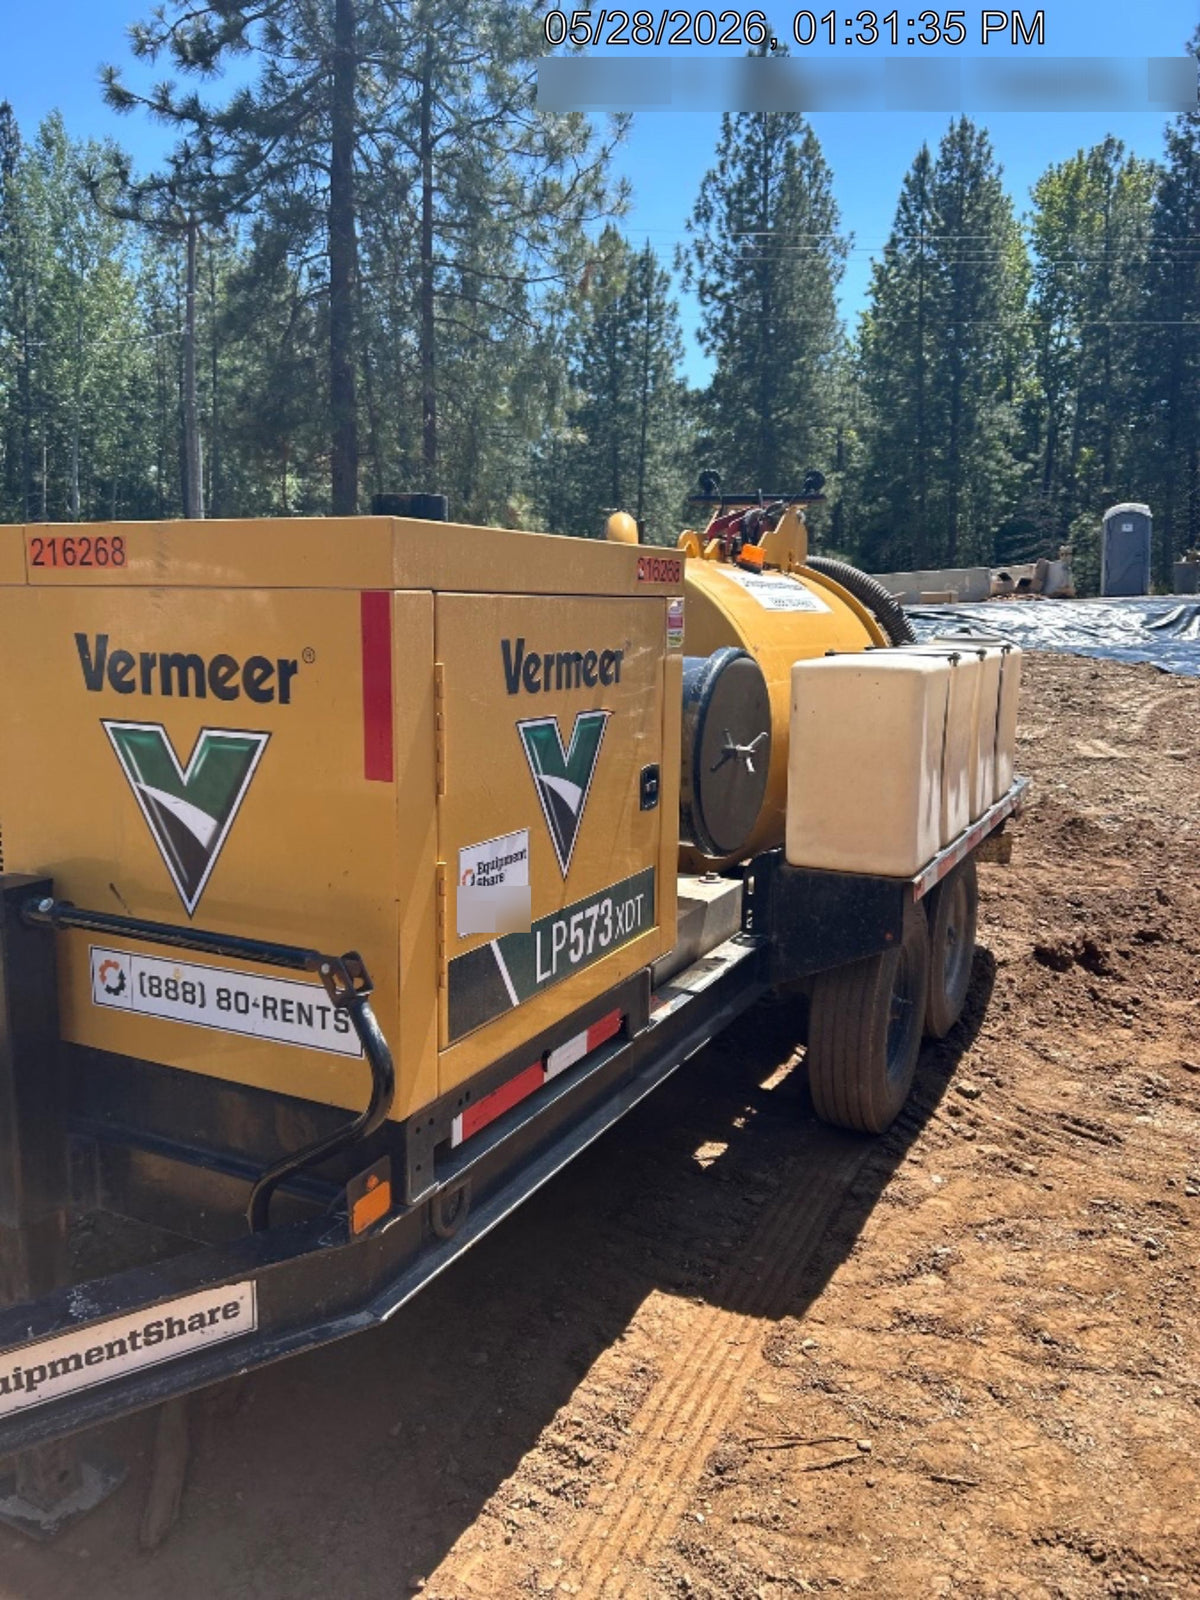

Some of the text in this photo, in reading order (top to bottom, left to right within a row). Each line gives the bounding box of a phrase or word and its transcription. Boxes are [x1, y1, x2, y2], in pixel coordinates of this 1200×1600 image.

[31, 536, 126, 567] 216268
[637, 557, 681, 583] 216268
[74, 632, 298, 705] Vermeer
[501, 637, 624, 695] Vermeer
[477, 849, 527, 876] Equipment
[139, 971, 350, 1033] (888) 80-RENTS
